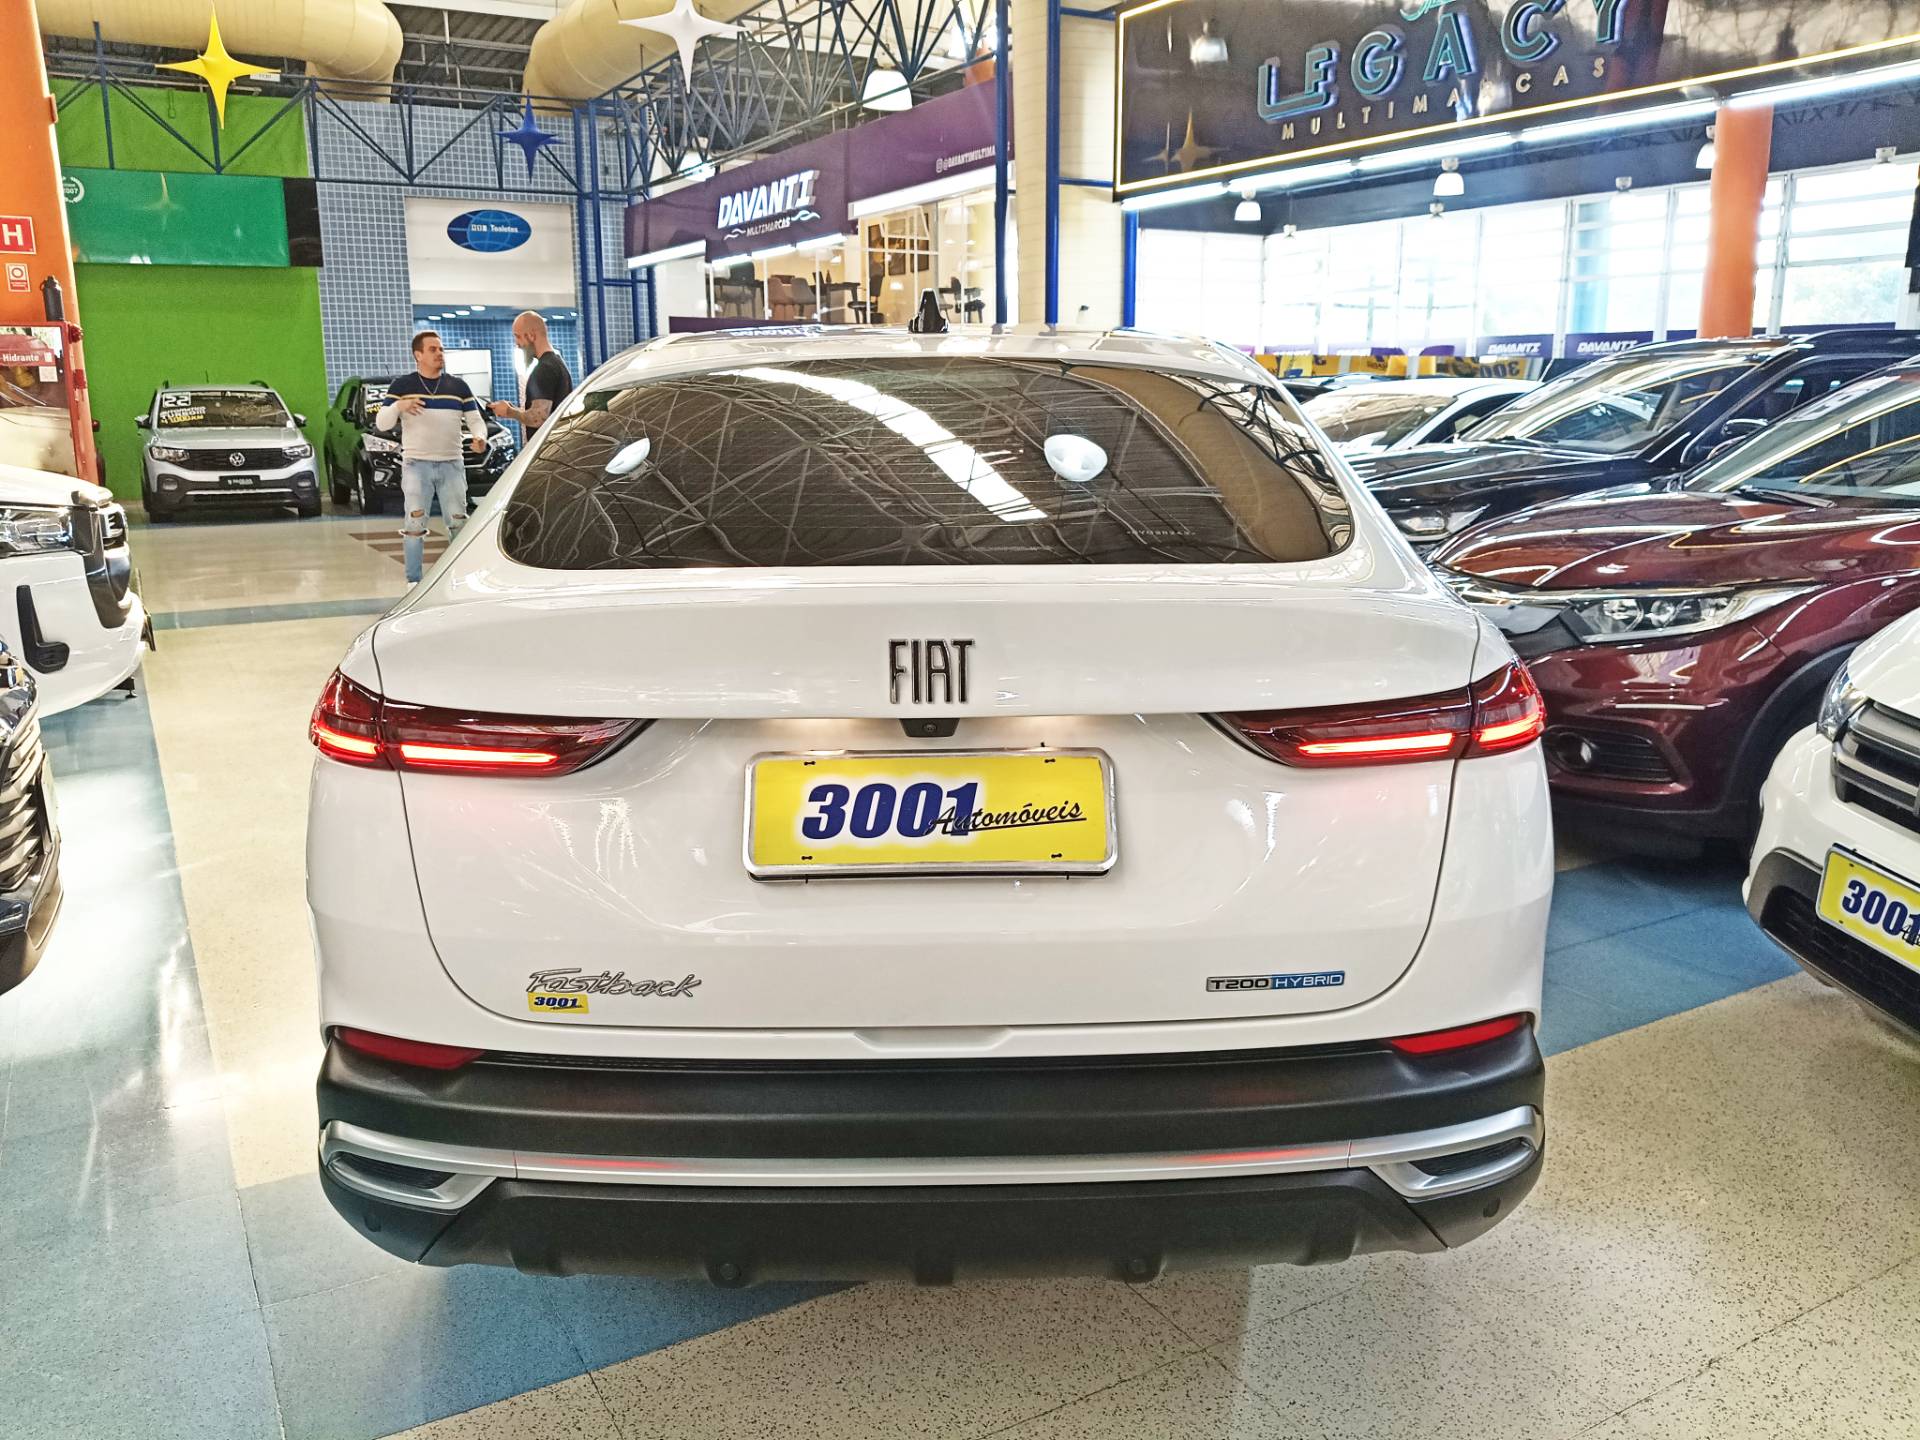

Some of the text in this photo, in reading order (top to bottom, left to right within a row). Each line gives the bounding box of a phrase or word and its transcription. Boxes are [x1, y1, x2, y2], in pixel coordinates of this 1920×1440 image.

[1256, 0, 1626, 120] LEGACY
[718, 170, 818, 229] DAVANTI
[2, 223, 24, 246] H
[746, 217, 791, 237] MULTIMARCAS
[1487, 342, 1541, 354] DAVANTI
[1577, 340, 1638, 353] DAVANTI
[165, 395, 190, 406] 22
[889, 639, 975, 704] FIAT
[802, 782, 1087, 840] 3001 Automóveis
[526, 967, 702, 998] Fastback
[1211, 975, 1343, 990] T200 HYBRID
[534, 996, 579, 1007] 3001
